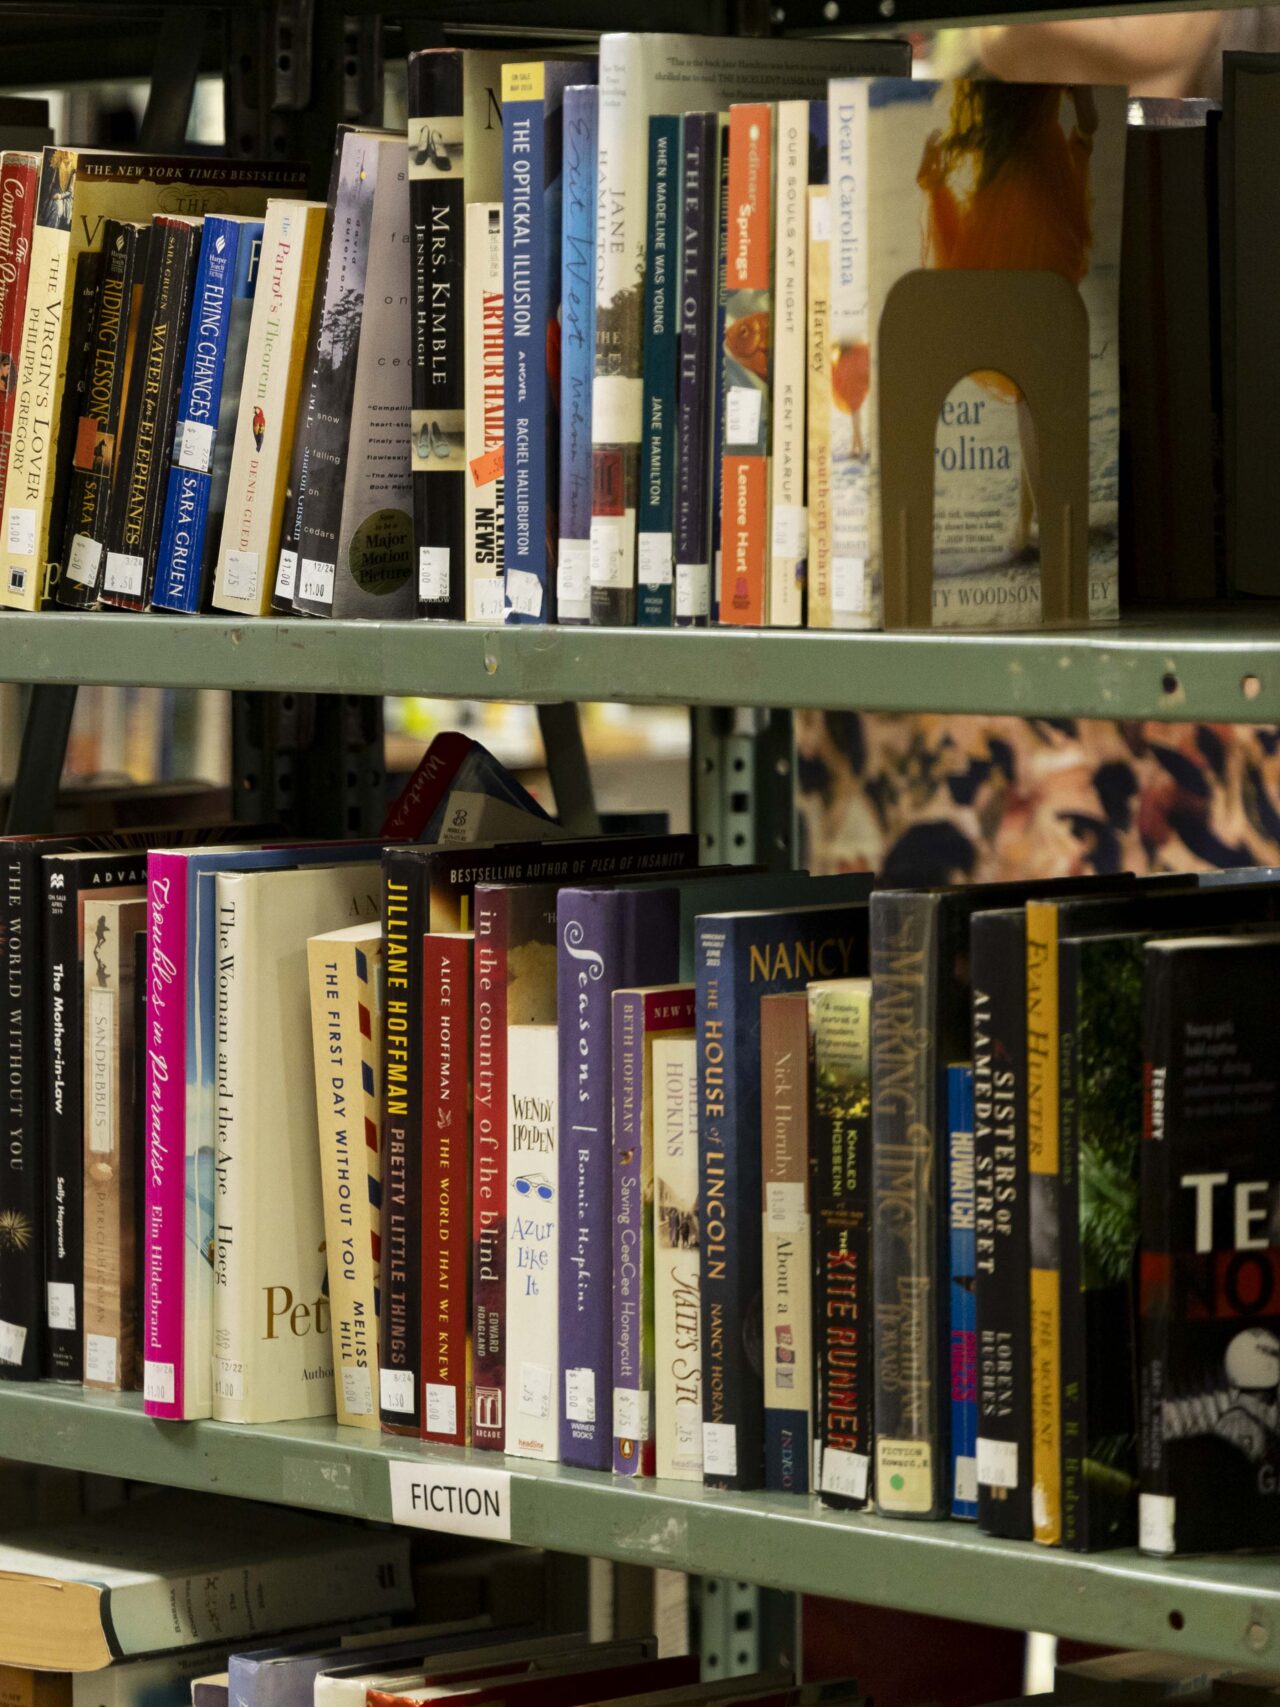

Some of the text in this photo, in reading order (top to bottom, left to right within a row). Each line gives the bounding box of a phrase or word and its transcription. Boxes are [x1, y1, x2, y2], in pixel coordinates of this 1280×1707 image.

[85, 164, 308, 183] THE NEW YORK TIMES BESTSELLER
[512, 119, 532, 338] THE OPTICKAL ILLUSION
[653, 136, 668, 336] WHEN MADELINE WAS YOUNG
[416, 224, 428, 367] JENNIFER HAIGH
[431, 205, 451, 386] MRS. KIMBLE
[683, 146, 700, 386] THE ALL OF IT
[13, 307, 40, 475] PHILIPPA GREGORY
[26, 256, 62, 501] THE VIRGIN'S LOVER
[190, 283, 225, 419] FLYING CHANGES
[125, 323, 171, 545] WATER for ELEPHANTS
[516, 418, 529, 557] RACHEL HALLIBURTON
[650, 396, 663, 506] JANE HAMILTON
[169, 478, 197, 598] SARA GRUEN
[280, 557, 292, 587] $1.00
[304, 526, 336, 541] cedars
[304, 582, 326, 598] $1.00
[313, 562, 334, 573] 12/24
[474, 508, 495, 565] NEWS
[958, 583, 1040, 607] WOODSON
[7, 861, 24, 1171] THE WORLD WITHOUT YOU
[52, 963, 66, 1116] The Mother-in-Law
[215, 901, 236, 1196] The Woman and the Ape
[387, 879, 409, 1116] JILLIANE HOFFMAN
[440, 956, 451, 1101] ALICE HOFFMAN
[564, 920, 605, 1103] Seasons
[623, 1003, 634, 1133] BETH HOFFMAN
[325, 962, 356, 1281] THE FIRST DAY WITHOUT YOU
[475, 909, 499, 1282] in the country of the blind
[512, 1094, 555, 1122] WENDY
[665, 1062, 684, 1158] HOPKINS
[704, 980, 727, 1281] THE HOUSE of LINCOLN
[973, 989, 996, 1275] ALAMEDA STREET
[993, 1070, 1017, 1237] SISTERS OF
[151, 1204, 164, 1349] Elin Hilderbrand
[391, 1127, 407, 1365] PRETTY LITTLE THINGS
[437, 1137, 450, 1381] THE WORLD THAT WE KNEW
[511, 1215, 555, 1240] Azur
[516, 1246, 549, 1270] Like
[526, 1273, 540, 1296] It
[570, 1148, 591, 1313] Bonnie Hopkins
[616, 1175, 637, 1378] Saving CeeCee Honeycutt
[340, 1320, 354, 1361] HILL
[387, 1393, 405, 1409] 1.50
[428, 1390, 440, 1421] $1.00
[411, 1483, 500, 1517] FICTION
[476, 1429, 502, 1439] ARCADE
